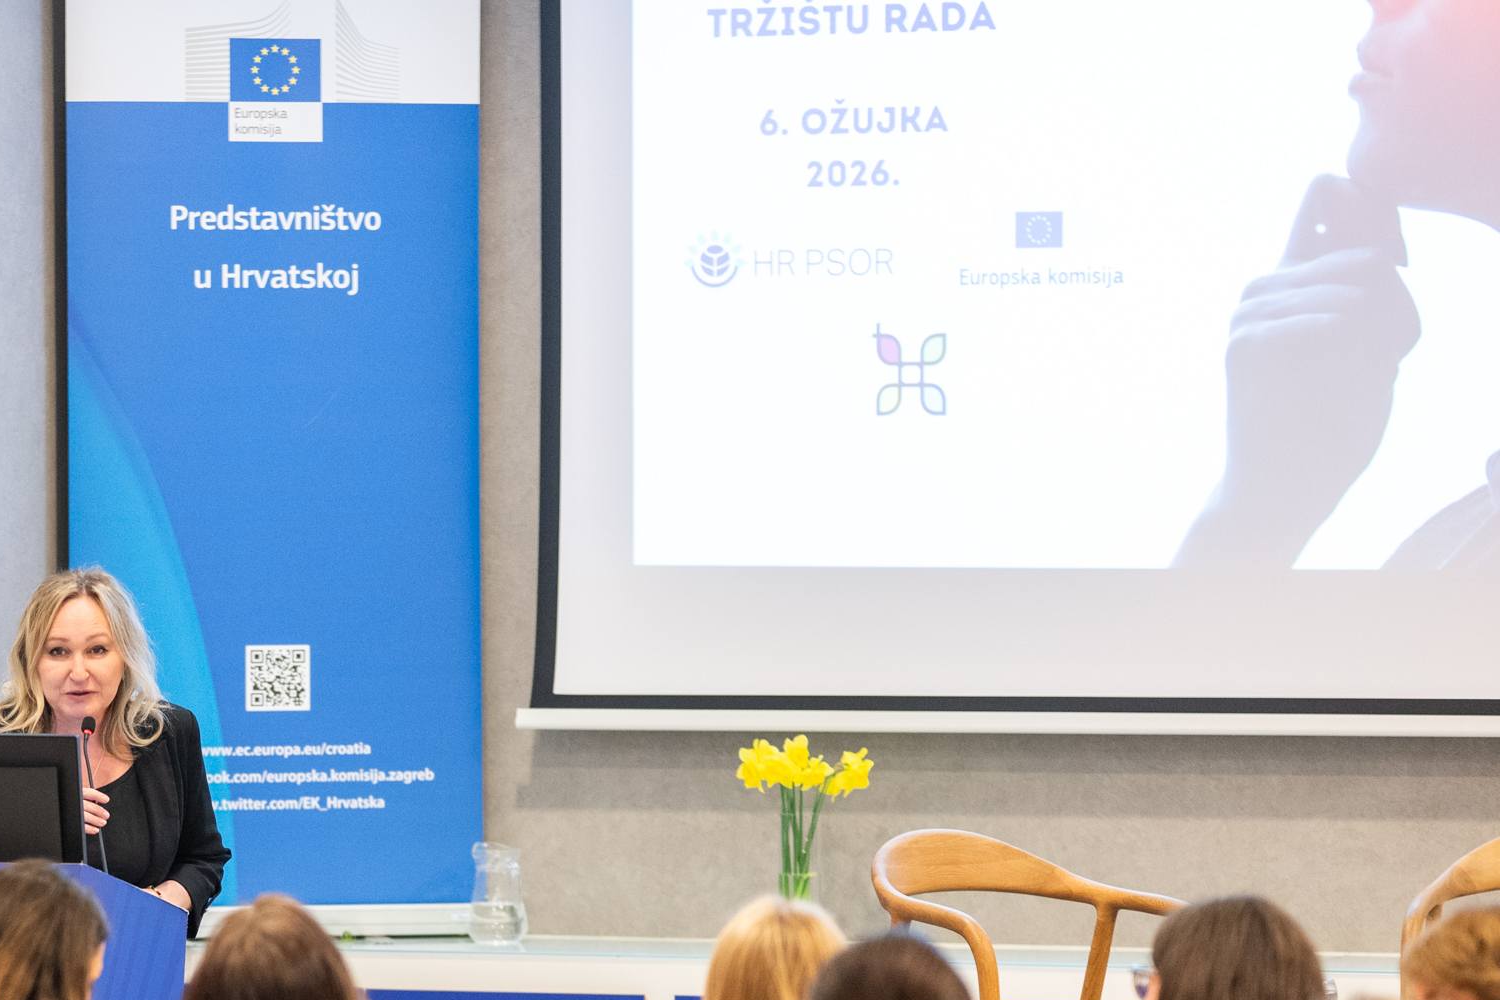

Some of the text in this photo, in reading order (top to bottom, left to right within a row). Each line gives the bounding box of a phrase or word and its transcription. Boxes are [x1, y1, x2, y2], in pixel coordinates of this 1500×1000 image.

[707, 0, 996, 38] TRŽIŠTU RADA
[233, 107, 288, 120] Europska
[760, 99, 948, 136] 6. OŽUJKA
[234, 123, 282, 137] komisija
[807, 160, 900, 187] 2026.
[170, 204, 381, 231] Predstavništvo
[754, 248, 893, 276] HR PSOR
[194, 263, 358, 295] u Hrvatskoj
[959, 267, 1125, 288] Europska komisija
[206, 768, 434, 785] ook.com/europska.komisija.zagreb
